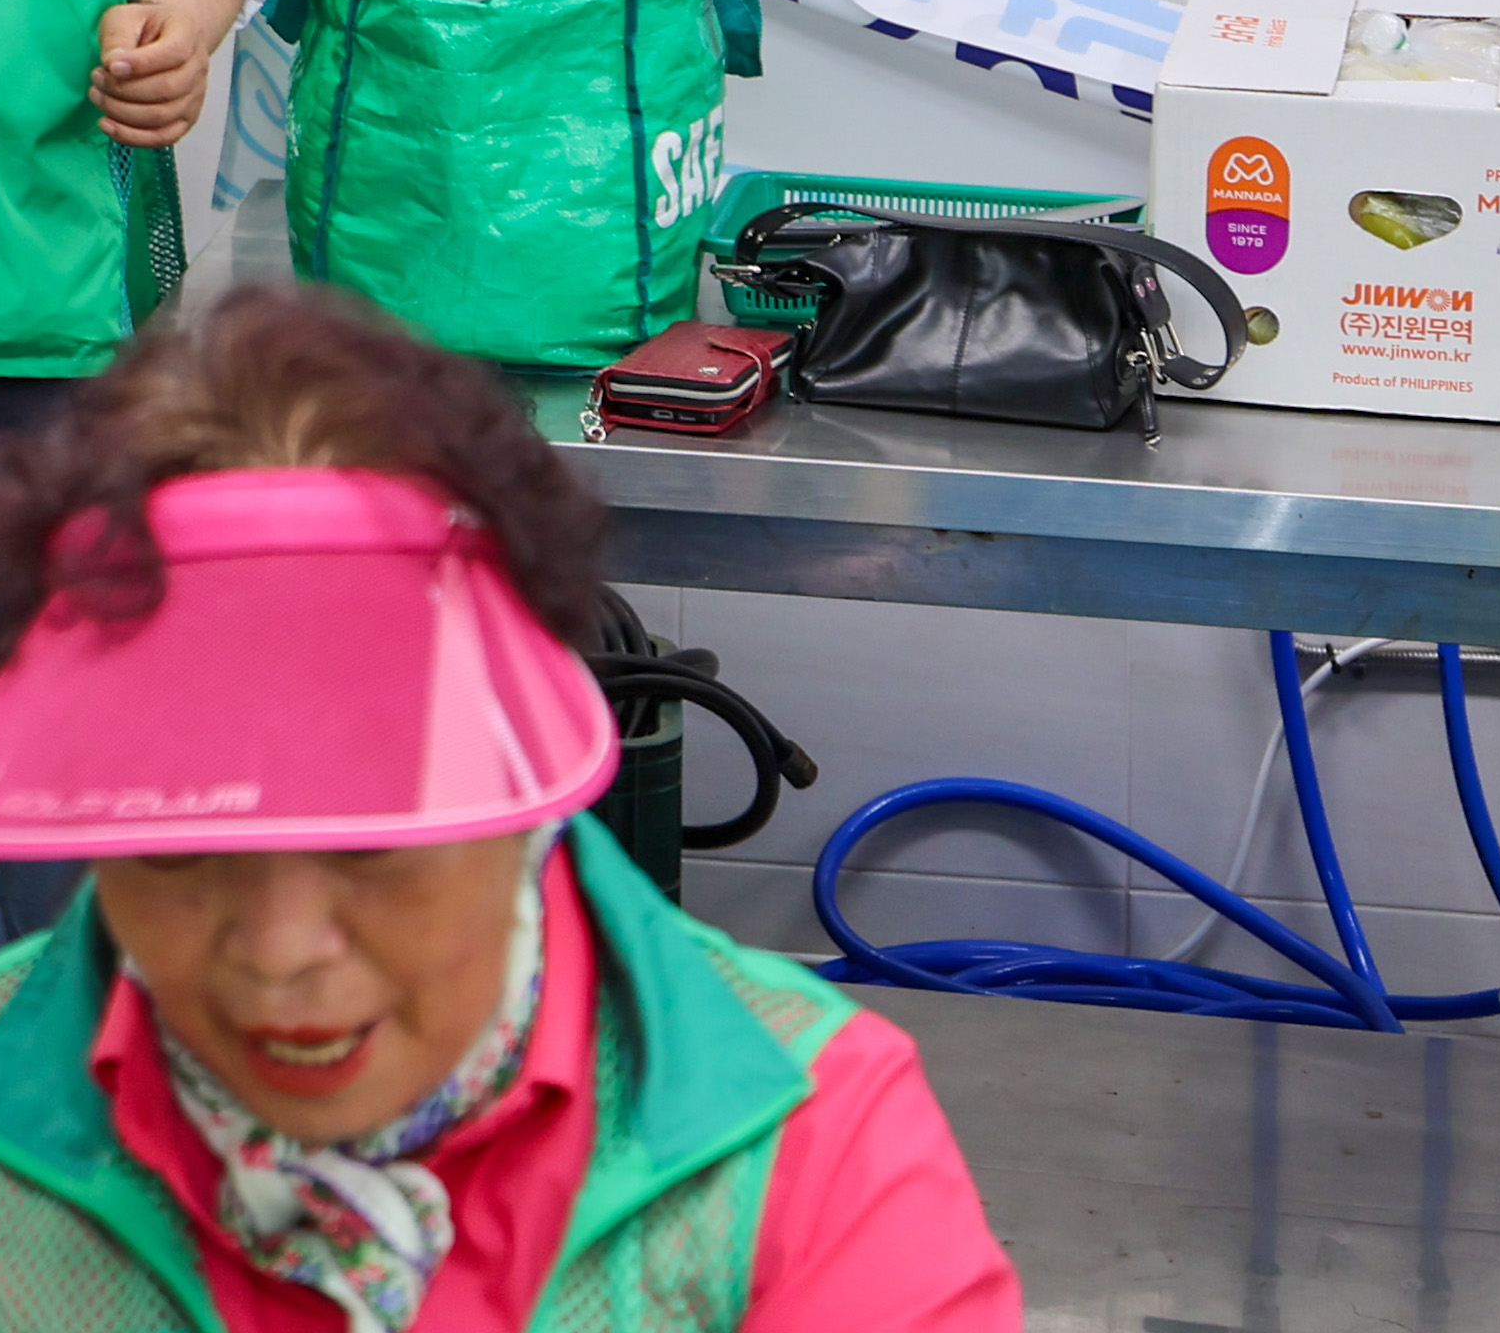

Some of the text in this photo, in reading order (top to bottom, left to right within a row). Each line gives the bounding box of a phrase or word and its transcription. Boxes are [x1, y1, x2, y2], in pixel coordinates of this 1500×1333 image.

[1213, 188, 1283, 203] MANNADA
[1227, 222, 1268, 235] SINCE
[1231, 236, 1264, 248] 1979
[1341, 283, 1473, 312] JINWON
[1340, 311, 1473, 345] (주)진원무역
[1341, 343, 1472, 363] www.jinwon.kr
[1332, 372, 1474, 393] Product of PHILIPPINES
